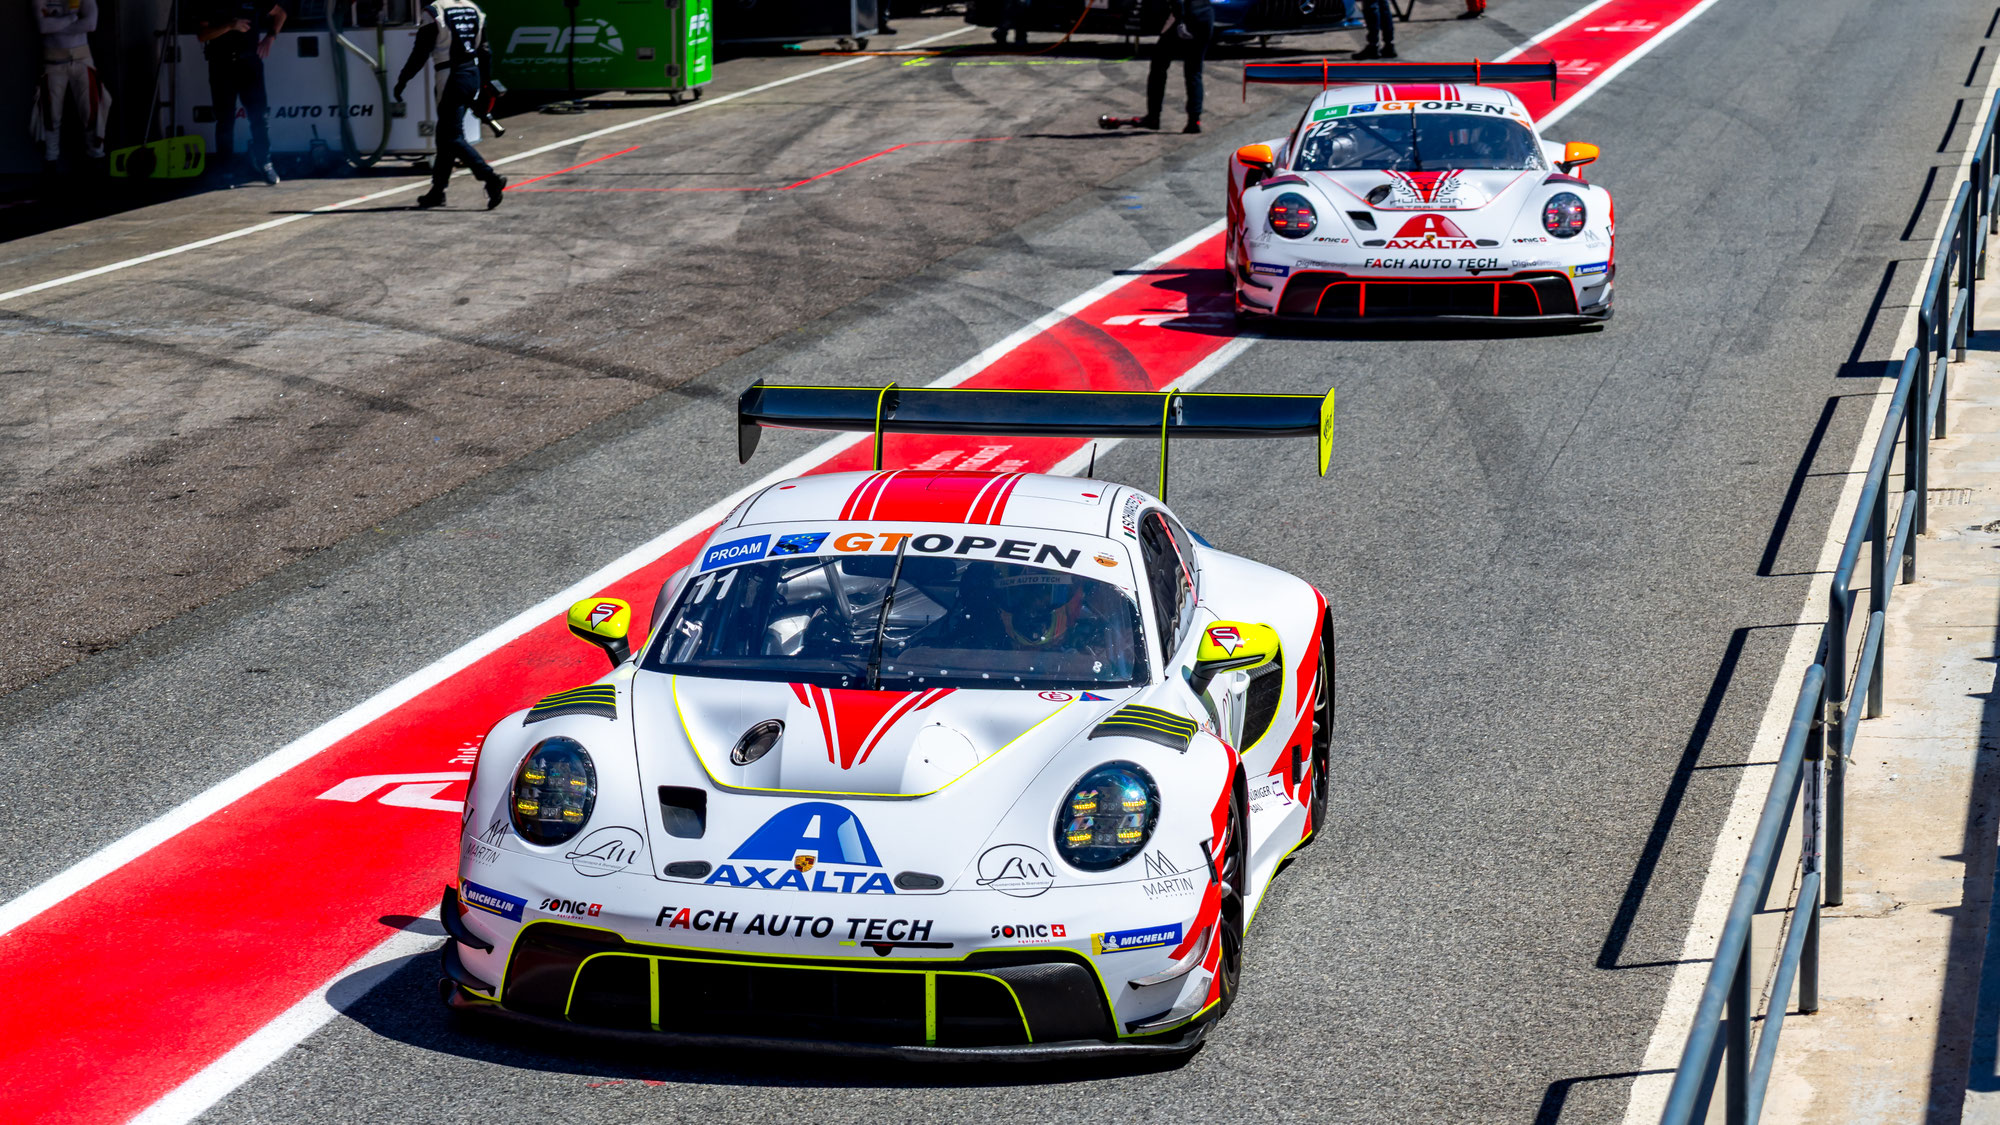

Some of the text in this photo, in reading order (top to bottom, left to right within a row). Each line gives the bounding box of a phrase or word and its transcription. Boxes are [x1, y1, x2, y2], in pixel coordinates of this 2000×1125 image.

[275, 106, 322, 118] AUTO
[328, 104, 373, 117] TCH
[1324, 108, 1338, 117] AM
[1308, 120, 1338, 138] 12
[1385, 239, 1478, 250] AXALTA
[1364, 257, 1498, 269] FACH AUTO TECH
[708, 541, 763, 564] PROAM
[693, 568, 739, 605] 11
[465, 842, 501, 863] MARTIN
[704, 864, 897, 894] AXALTA
[1142, 877, 1194, 896] MARTIN
[467, 890, 515, 912] MICHELIN
[655, 905, 934, 941] FACH AUTO TECH
[1120, 930, 1176, 946] MICHELIN
